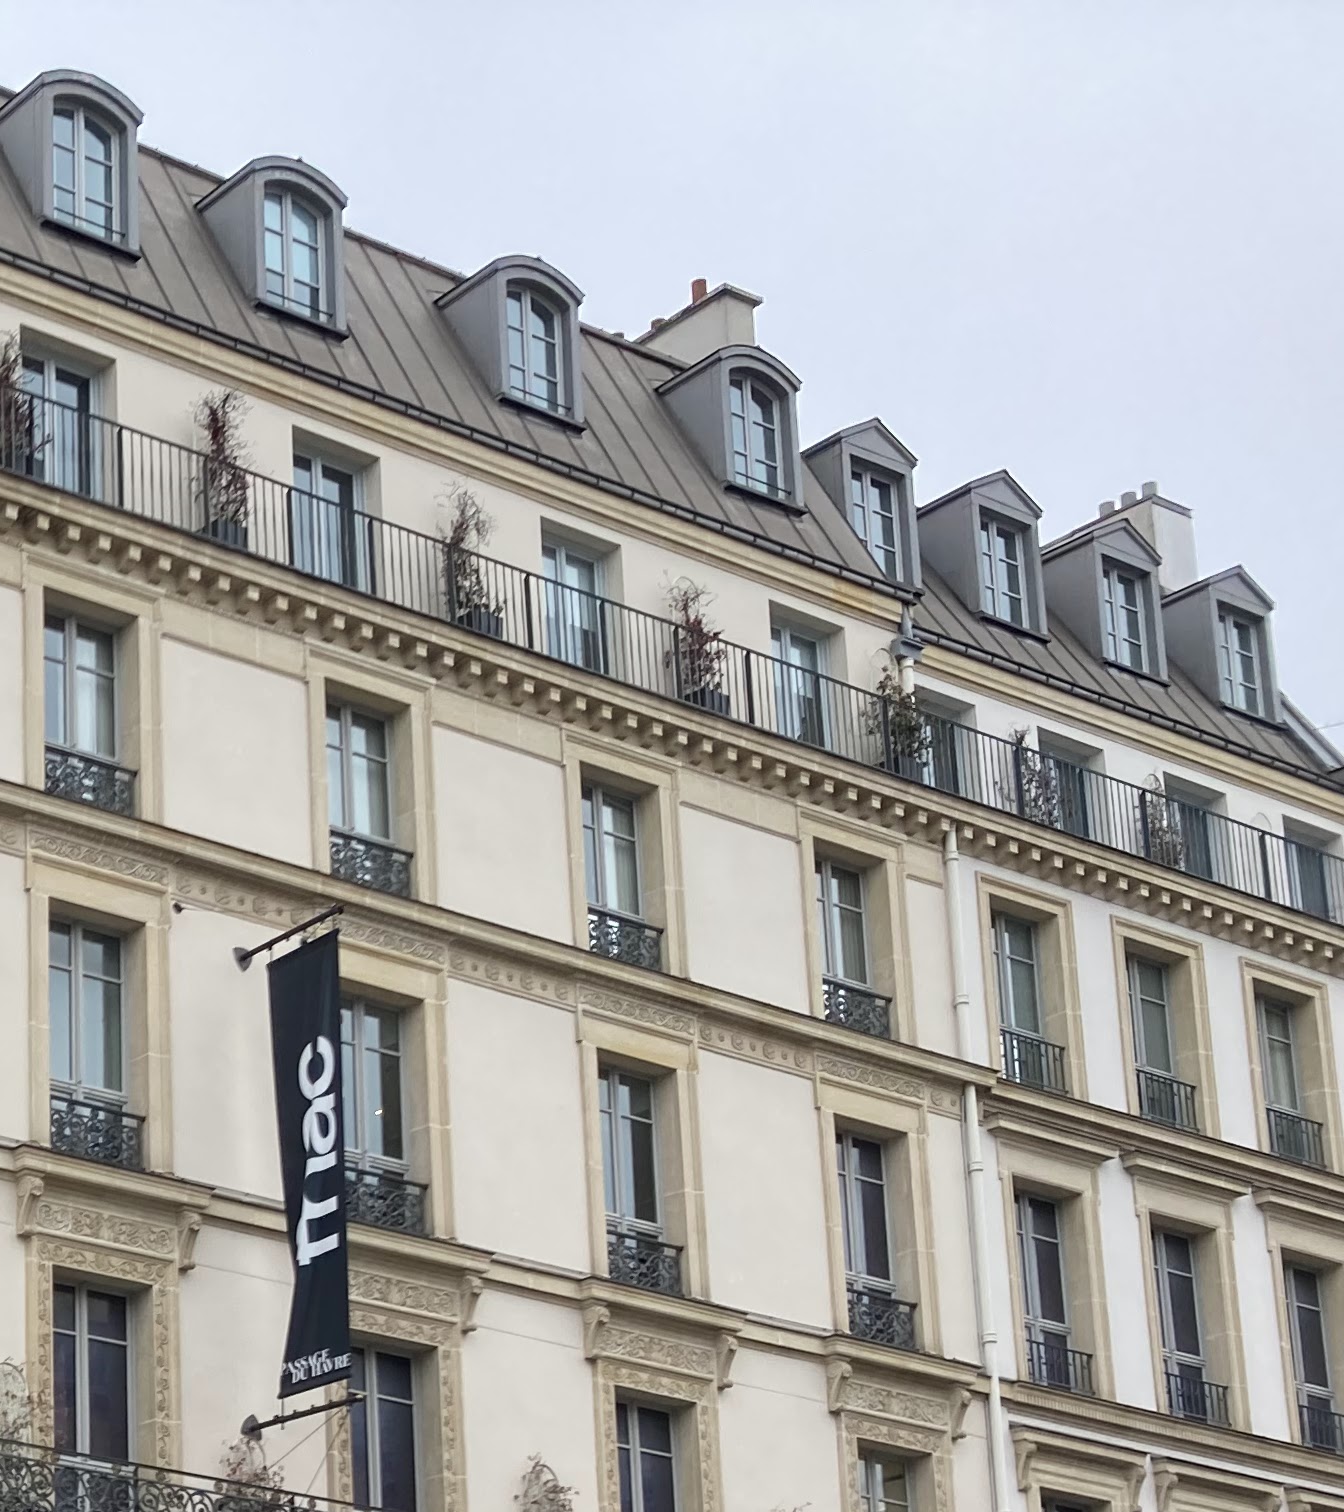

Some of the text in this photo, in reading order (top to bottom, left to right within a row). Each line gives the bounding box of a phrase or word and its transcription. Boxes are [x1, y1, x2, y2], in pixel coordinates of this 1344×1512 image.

[295, 1035, 337, 1267] fnac
[282, 1348, 330, 1374] PASSAGE
[291, 1352, 352, 1384] DU HAVRE
